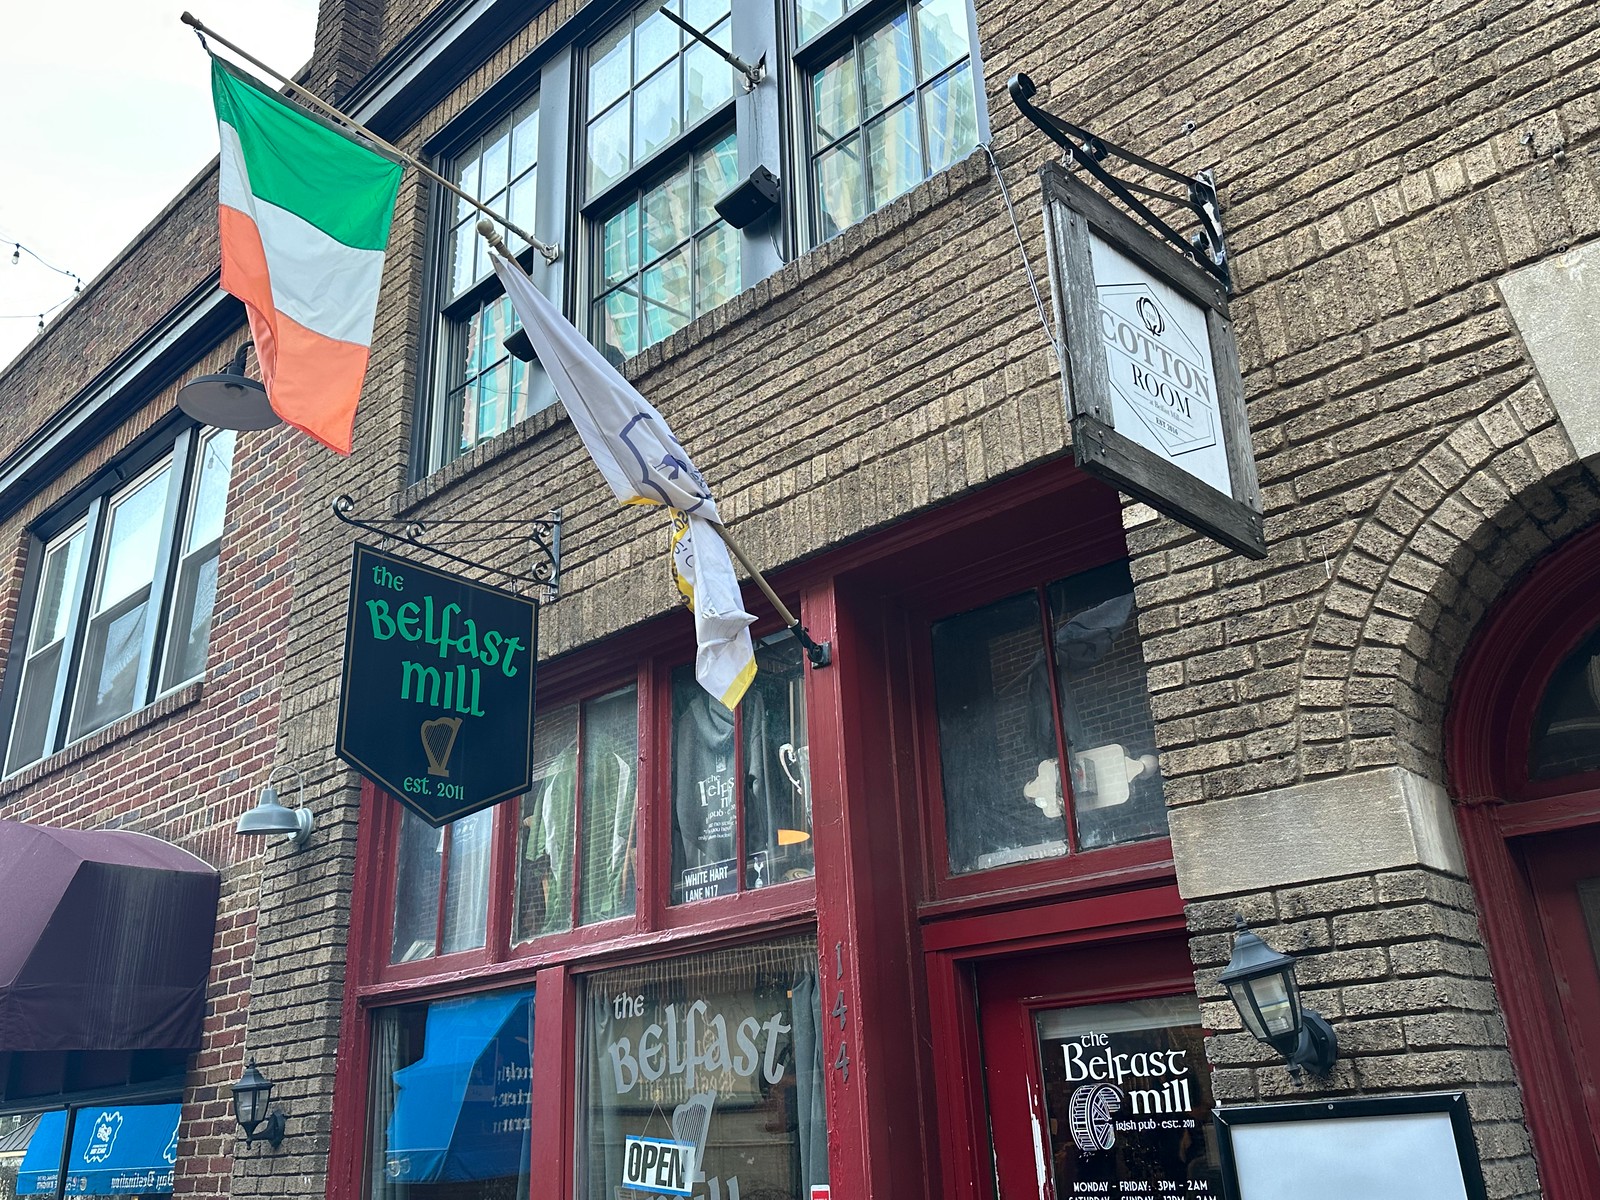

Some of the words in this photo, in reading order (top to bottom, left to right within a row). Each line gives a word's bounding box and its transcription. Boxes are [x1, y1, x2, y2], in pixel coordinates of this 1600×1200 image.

[1098, 309, 1211, 403] COTTON
[1131, 362, 1193, 419] ROOM
[372, 565, 404, 591] the
[366, 595, 525, 678] Belfast
[400, 660, 485, 718] mill
[403, 776, 432, 795] est.
[437, 782, 465, 801] 2011
[685, 870, 708, 887] WHITE
[709, 866, 729, 882] HART
[685, 887, 704, 903] LANE
[704, 884, 719, 899] N17
[613, 992, 644, 1020] the
[608, 999, 791, 1094] Belfast
[1081, 1030, 1109, 1048] the
[1061, 1042, 1189, 1085] Belfast
[1128, 1078, 1192, 1115] mill
[1138, 1118, 1156, 1132] pub
[1161, 1119, 1181, 1129] est.
[1182, 1119, 1195, 1128] 2011
[627, 1142, 687, 1189] OPEN
[1073, 1182, 1109, 1192] MONDAY
[1119, 1181, 1152, 1192] FRIDAY:
[1157, 1181, 1176, 1191] 3PM
[1186, 1180, 1208, 1191] 2AM
